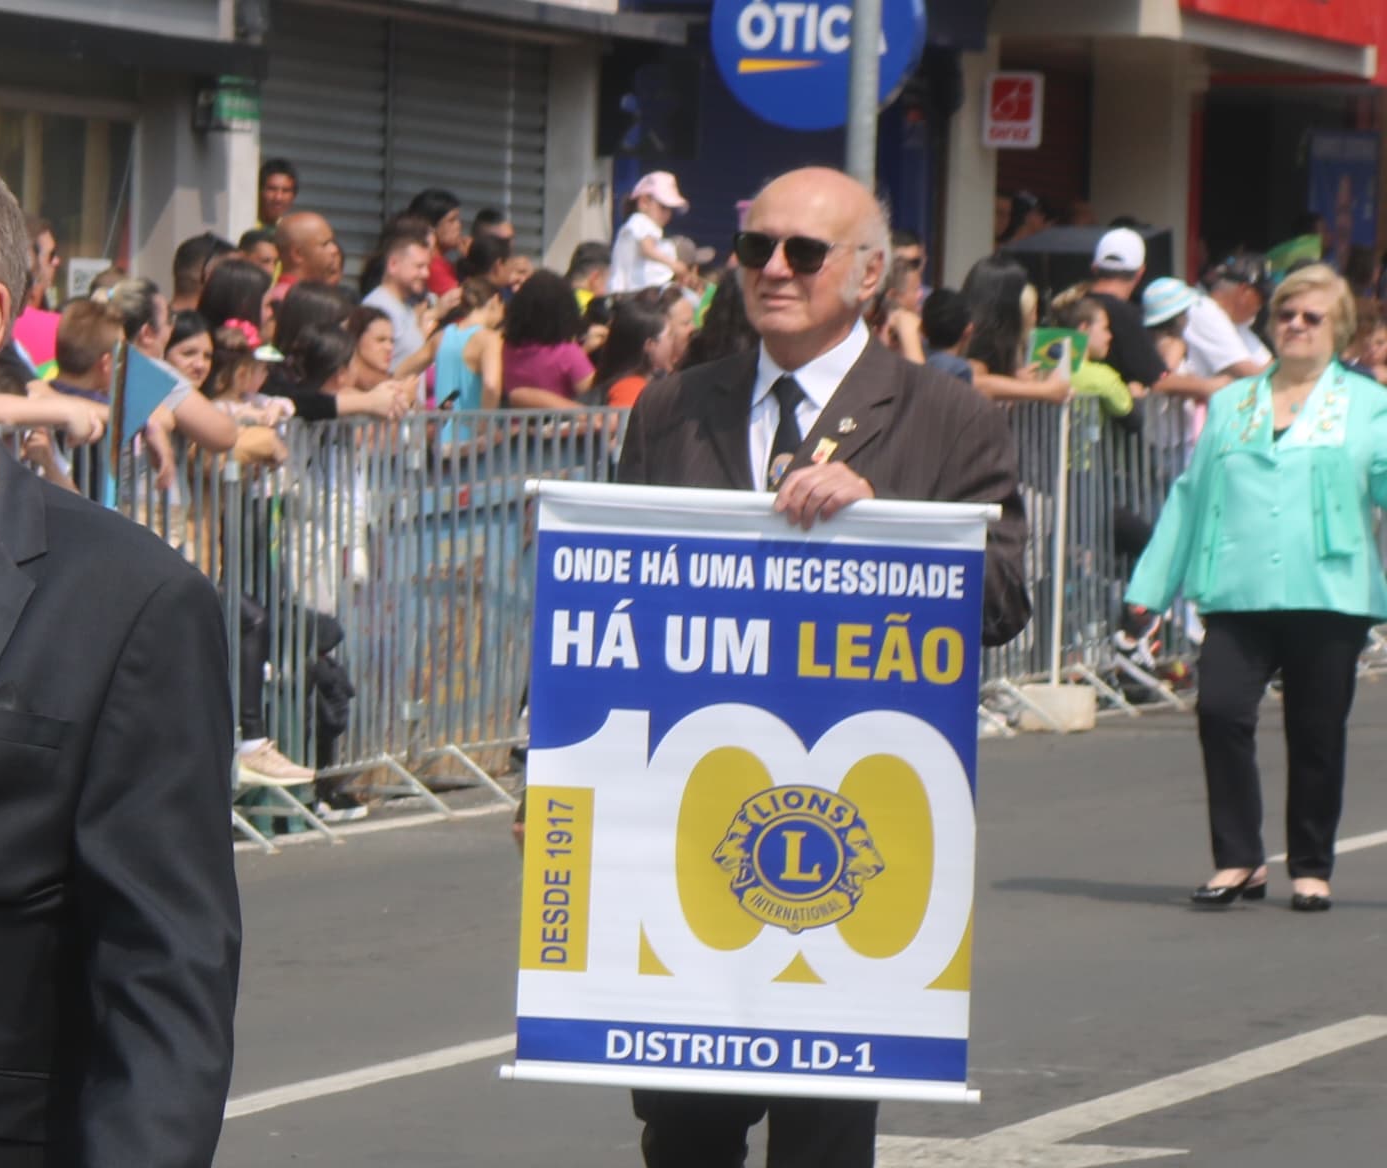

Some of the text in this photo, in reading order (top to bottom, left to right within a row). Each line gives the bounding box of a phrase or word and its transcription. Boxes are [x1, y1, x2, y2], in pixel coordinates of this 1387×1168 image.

[737, 0, 887, 56] ÓTIC
[552, 544, 966, 600] ONDE HÁ UMA NECESSIDADE
[550, 600, 965, 685] HÁ UM LEÃO
[753, 790, 849, 823] LIONS
[527, 702, 977, 990] 100
[779, 830, 822, 882] L
[541, 798, 575, 965] DESDE 1917
[750, 893, 845, 922] INTERNATIONAL
[605, 1027, 876, 1073] DISTRITO LD-1
